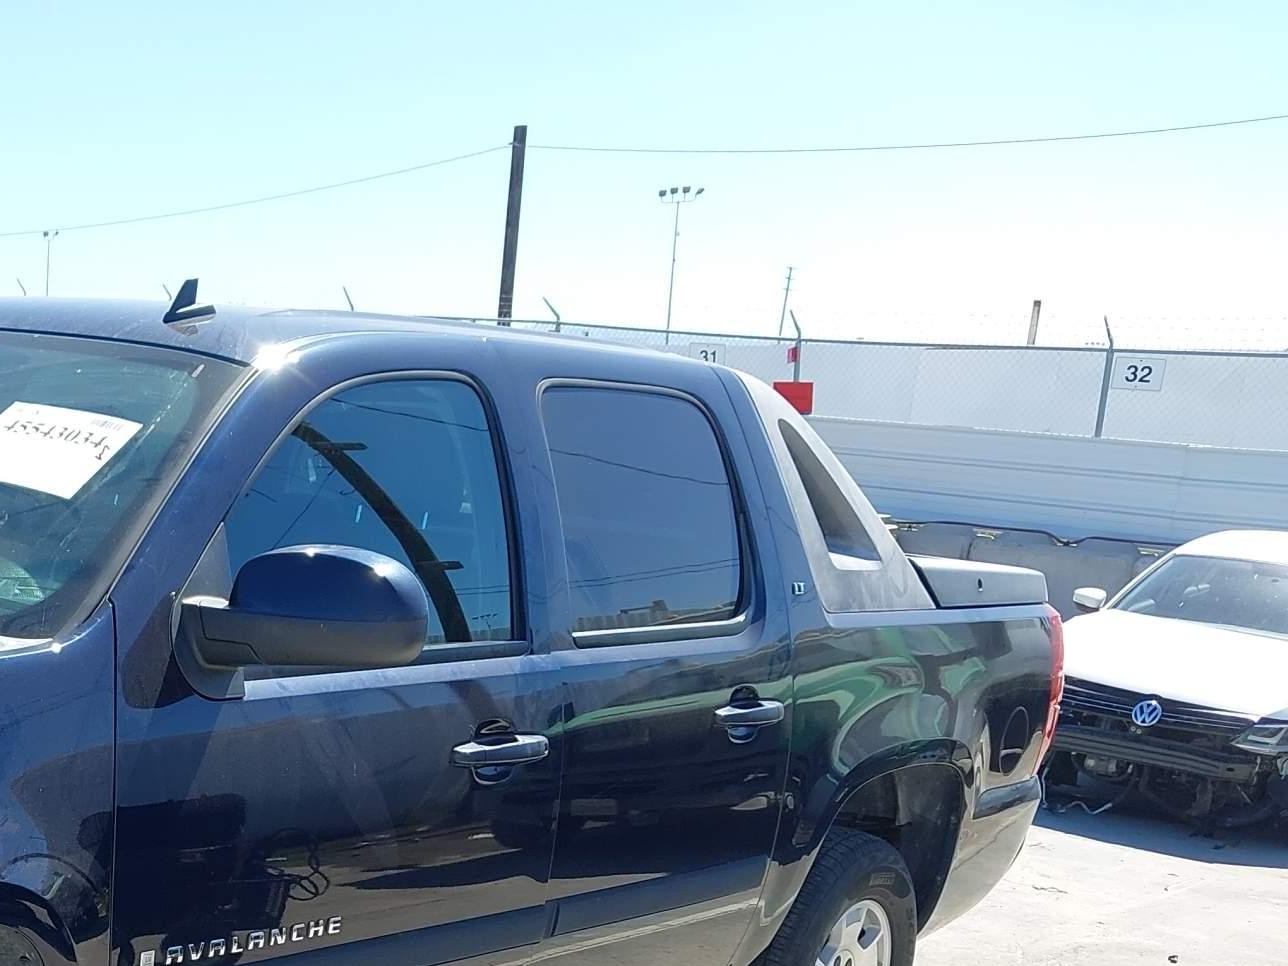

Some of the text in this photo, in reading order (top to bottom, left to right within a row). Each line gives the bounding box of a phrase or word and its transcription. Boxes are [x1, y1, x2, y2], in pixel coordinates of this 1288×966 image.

[700, 349, 717, 363] 31
[1124, 365, 1153, 383] 32
[165, 916, 342, 966] AVALANCHE
